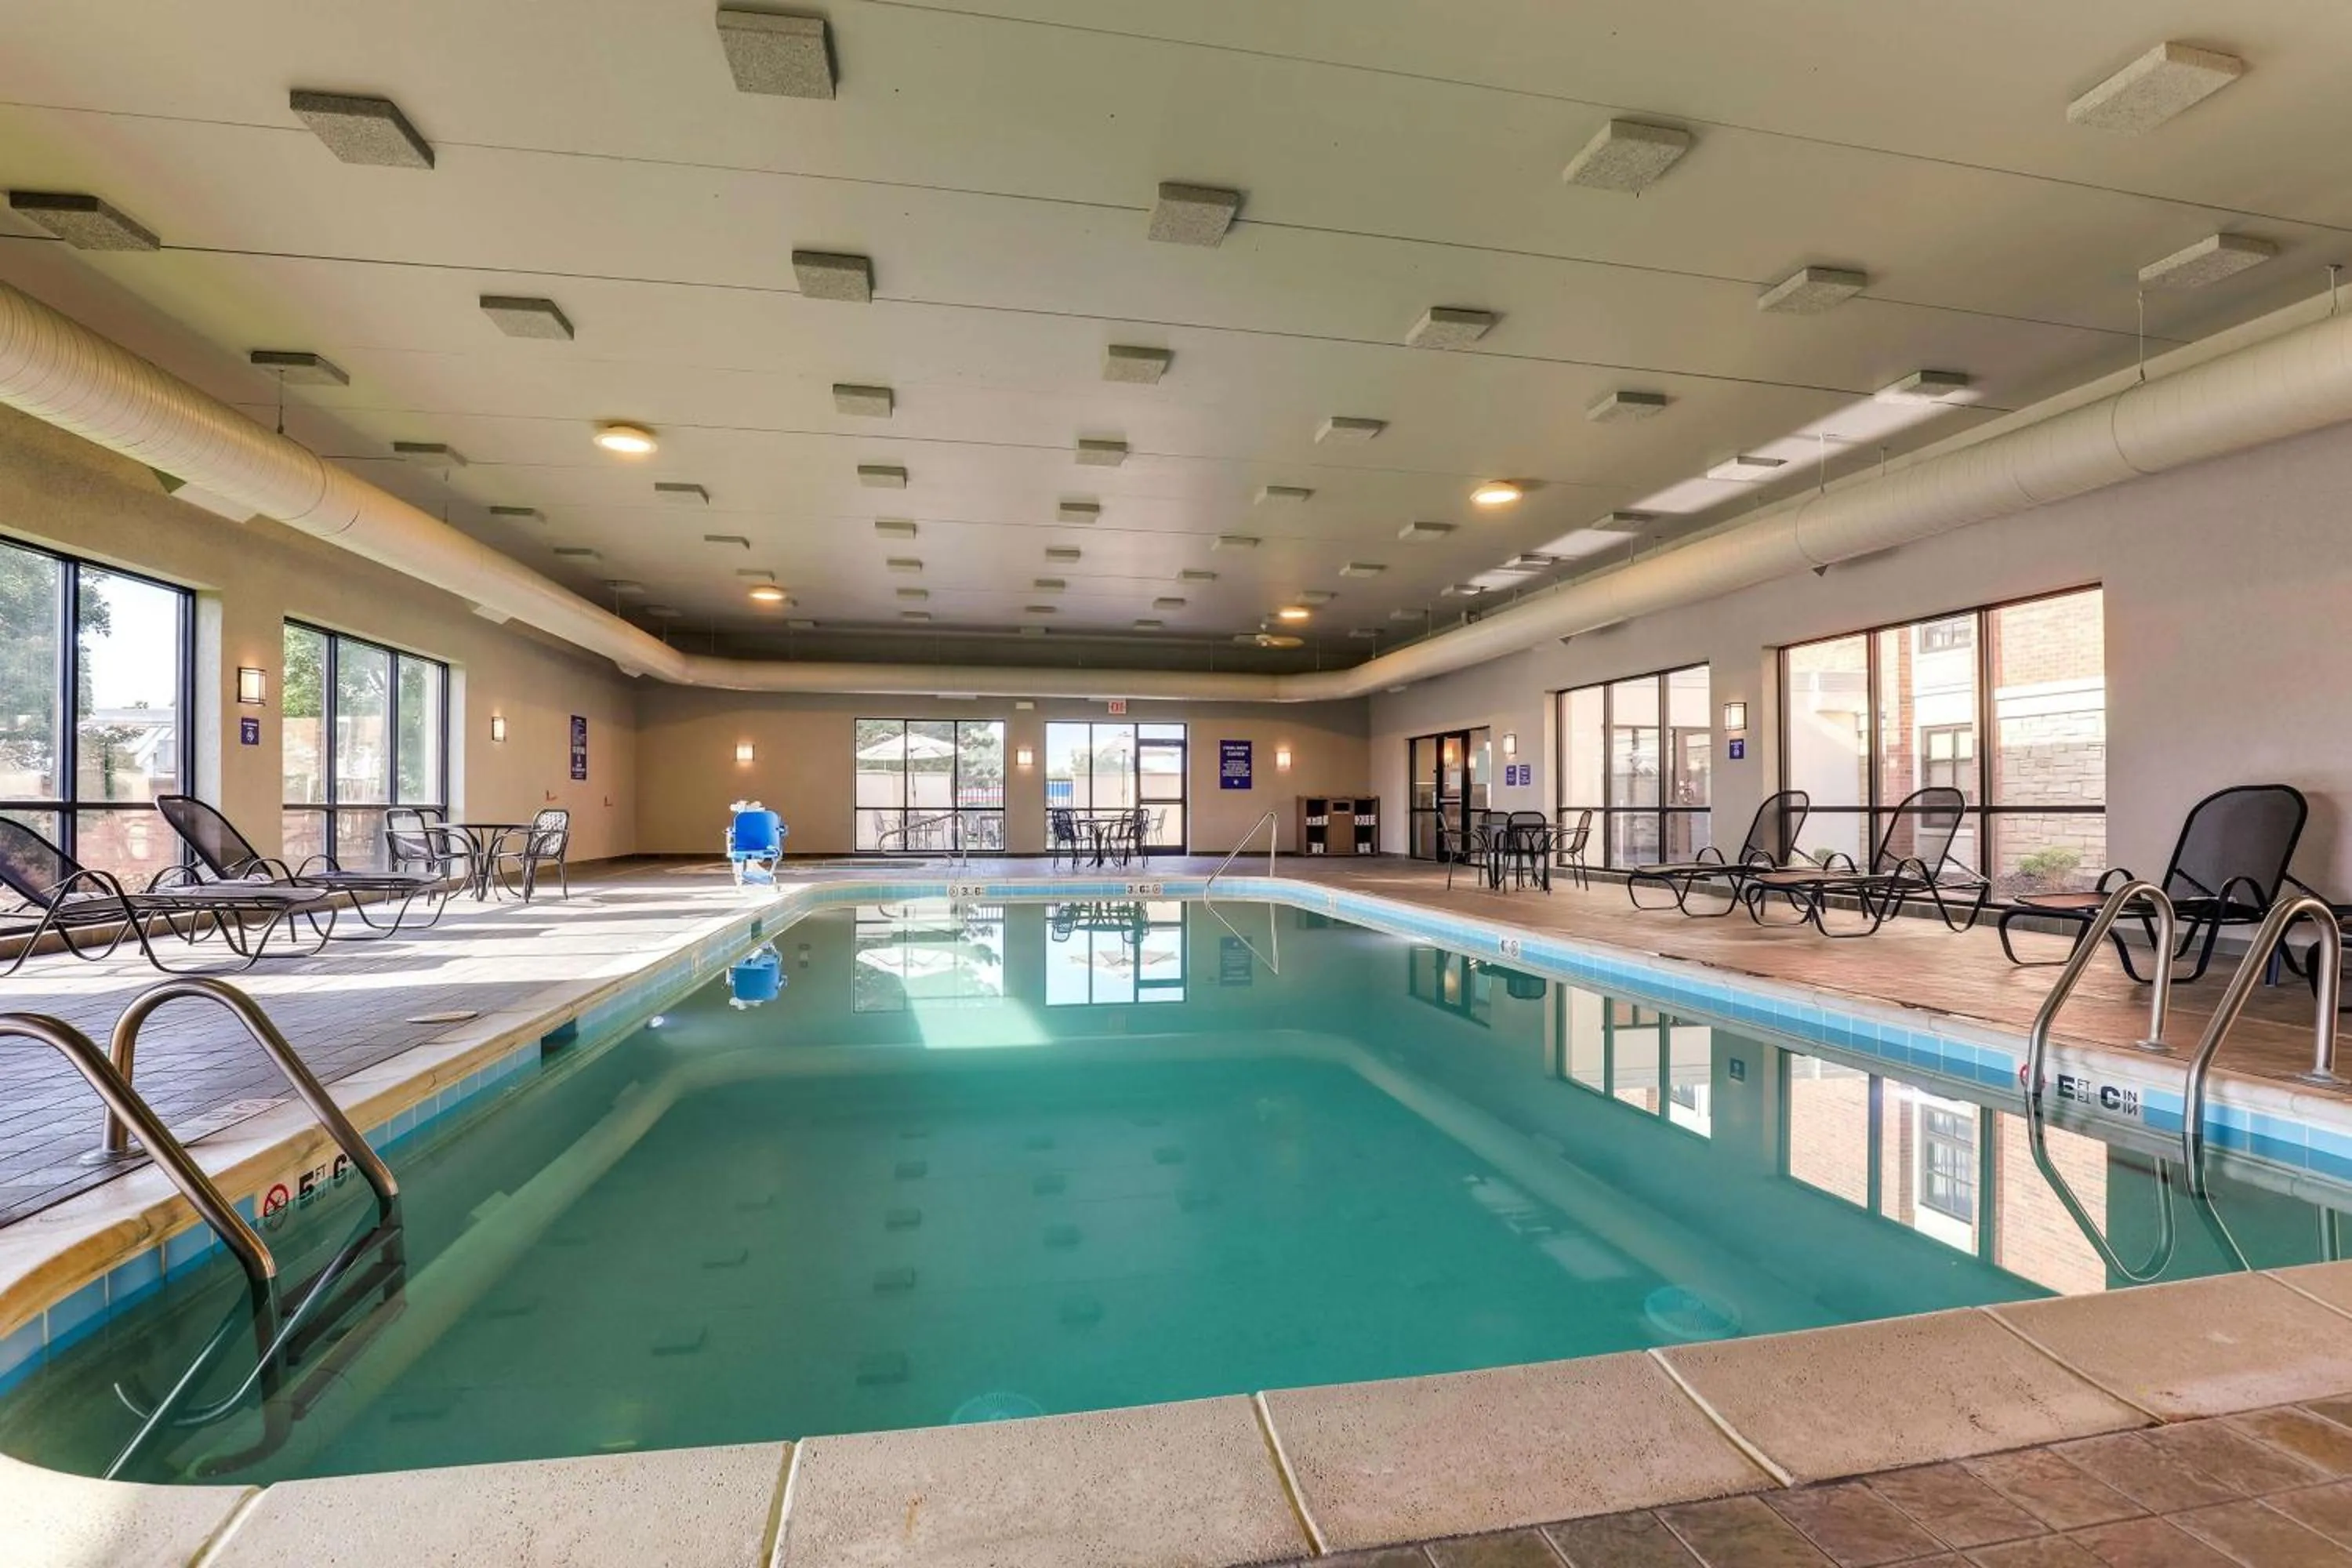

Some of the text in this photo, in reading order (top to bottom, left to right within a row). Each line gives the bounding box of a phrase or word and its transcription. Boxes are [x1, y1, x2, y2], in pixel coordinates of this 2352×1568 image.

[2123, 1090, 2137, 1102] IN
[299, 1171, 315, 1200] 5
[315, 1163, 326, 1181] FT
[333, 1154, 347, 1179] 6
